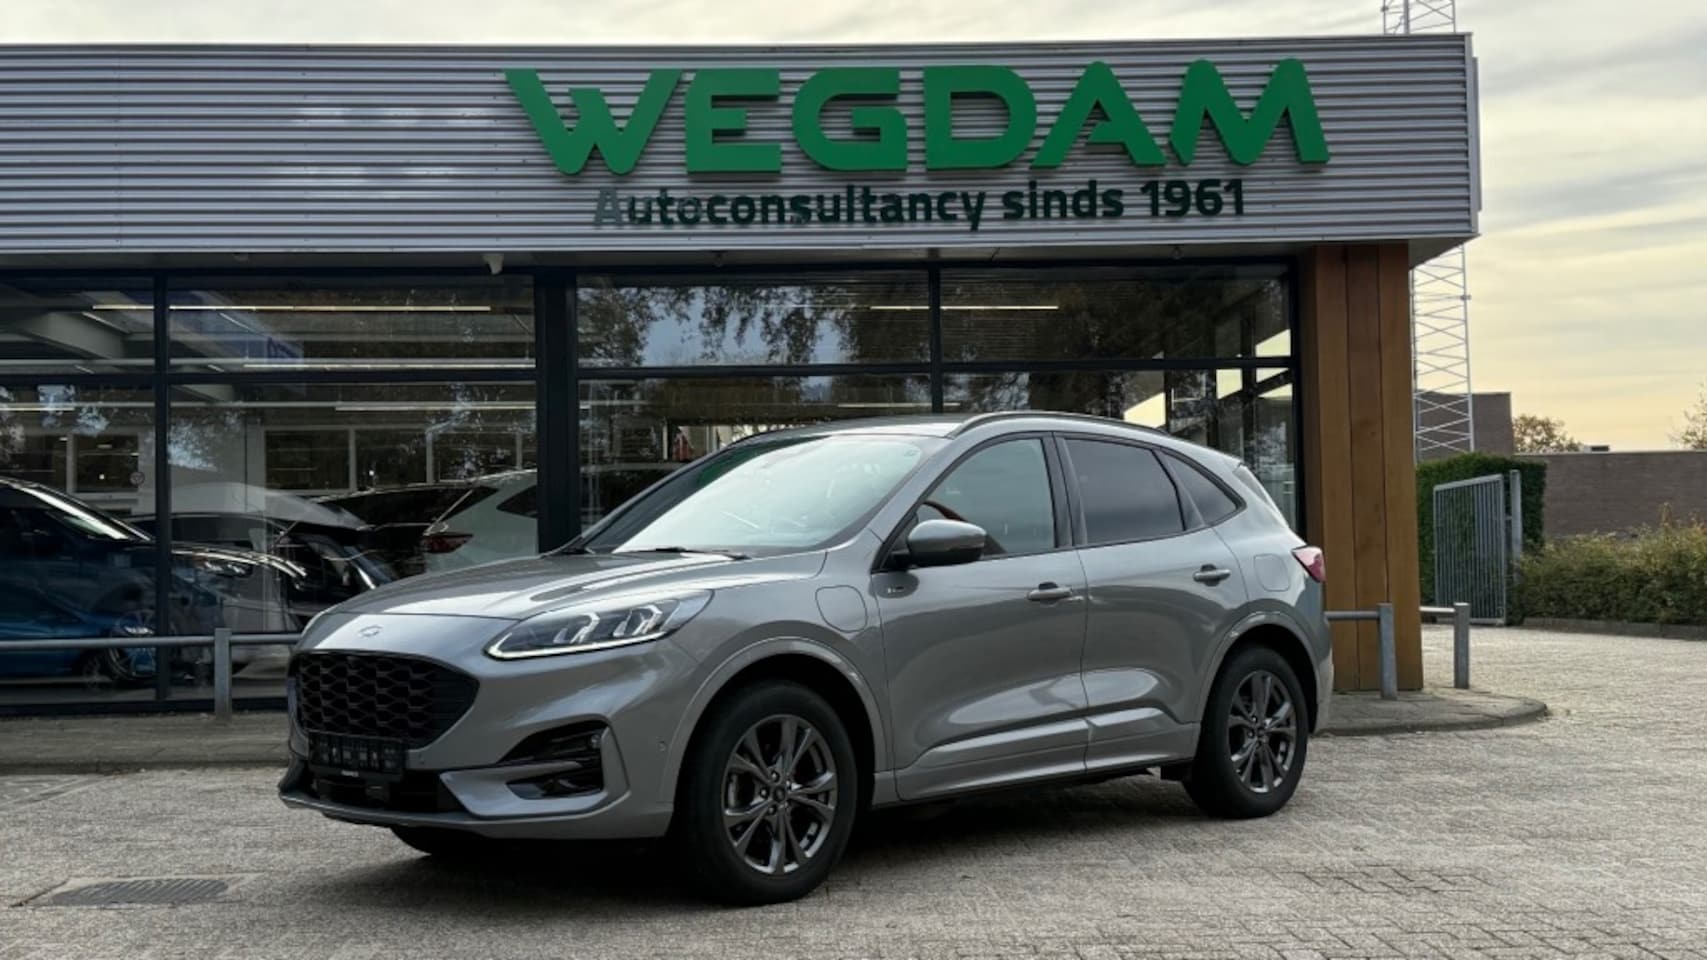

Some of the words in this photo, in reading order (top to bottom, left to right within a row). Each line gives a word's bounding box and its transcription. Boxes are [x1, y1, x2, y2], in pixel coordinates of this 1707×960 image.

[504, 58, 1330, 175] WEGDAM
[595, 184, 986, 231] Autoconsultancy
[1003, 180, 1124, 220] sinds
[1140, 178, 1245, 217] 1961
